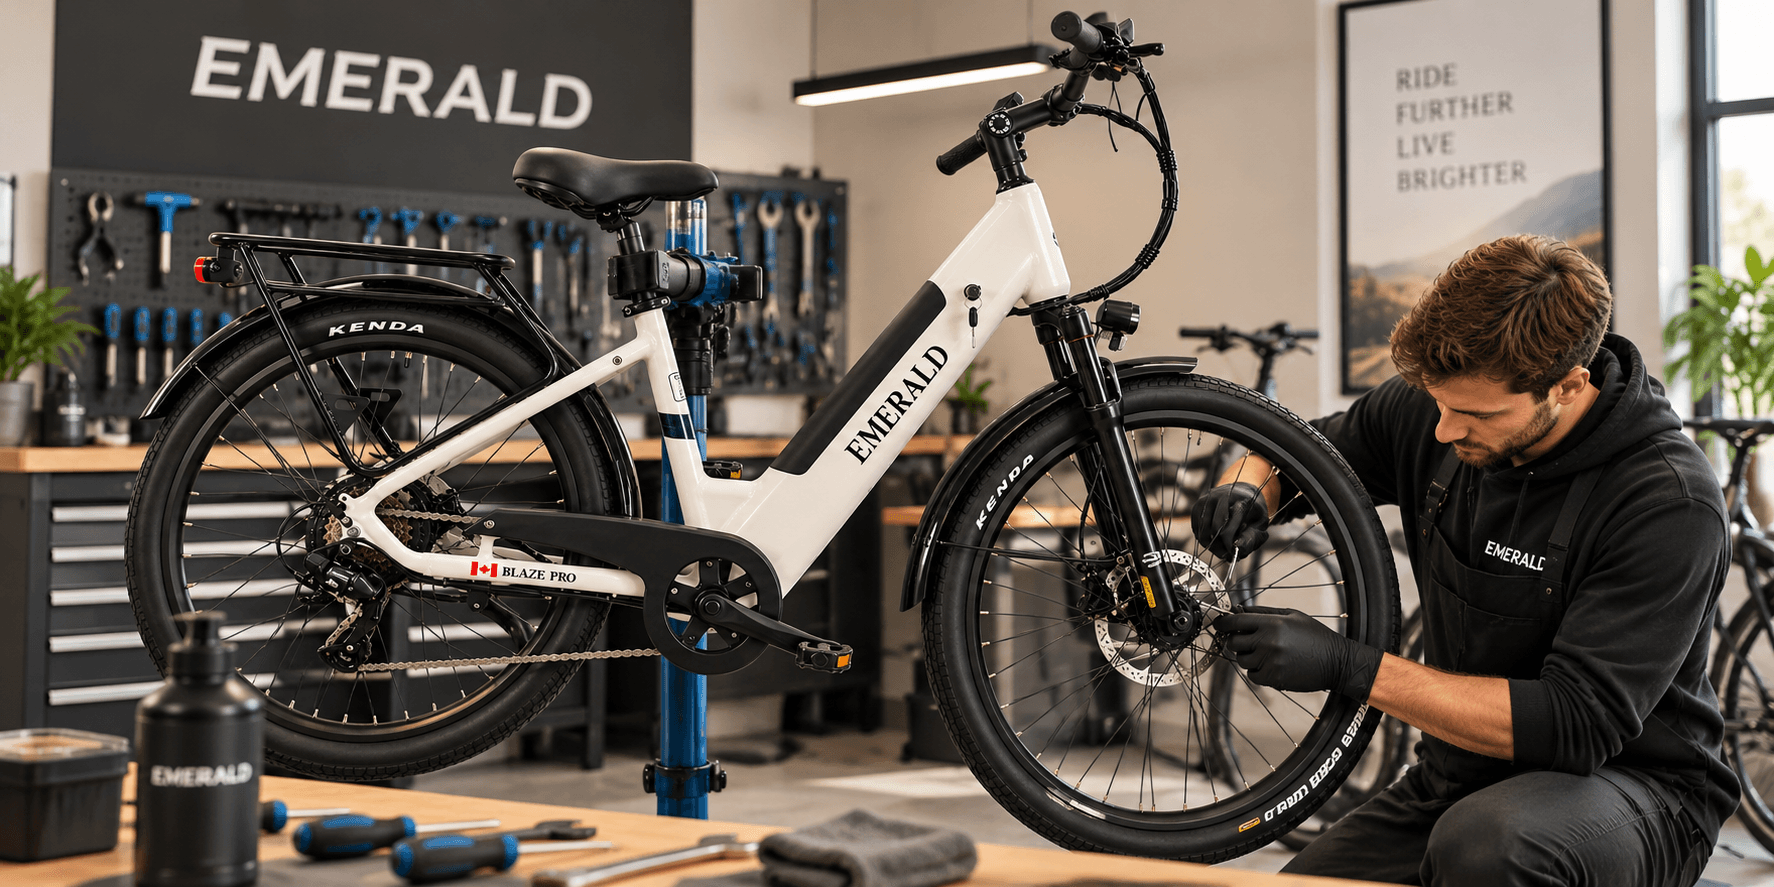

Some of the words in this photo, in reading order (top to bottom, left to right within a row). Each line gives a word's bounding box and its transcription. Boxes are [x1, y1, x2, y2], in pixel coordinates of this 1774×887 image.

[190, 35, 593, 130] EMERALD
[1396, 62, 1457, 91] RIDE
[1396, 91, 1513, 125] FURTHER
[1397, 131, 1455, 159] LIVE
[1397, 160, 1527, 192] BRIGHTER
[328, 321, 424, 337] KENDA
[844, 346, 948, 465] EMERALD
[976, 454, 1034, 530] KENDA
[502, 566, 545, 580] BLAZE
[550, 571, 577, 583] PRO
[151, 762, 253, 787] EMERALD
